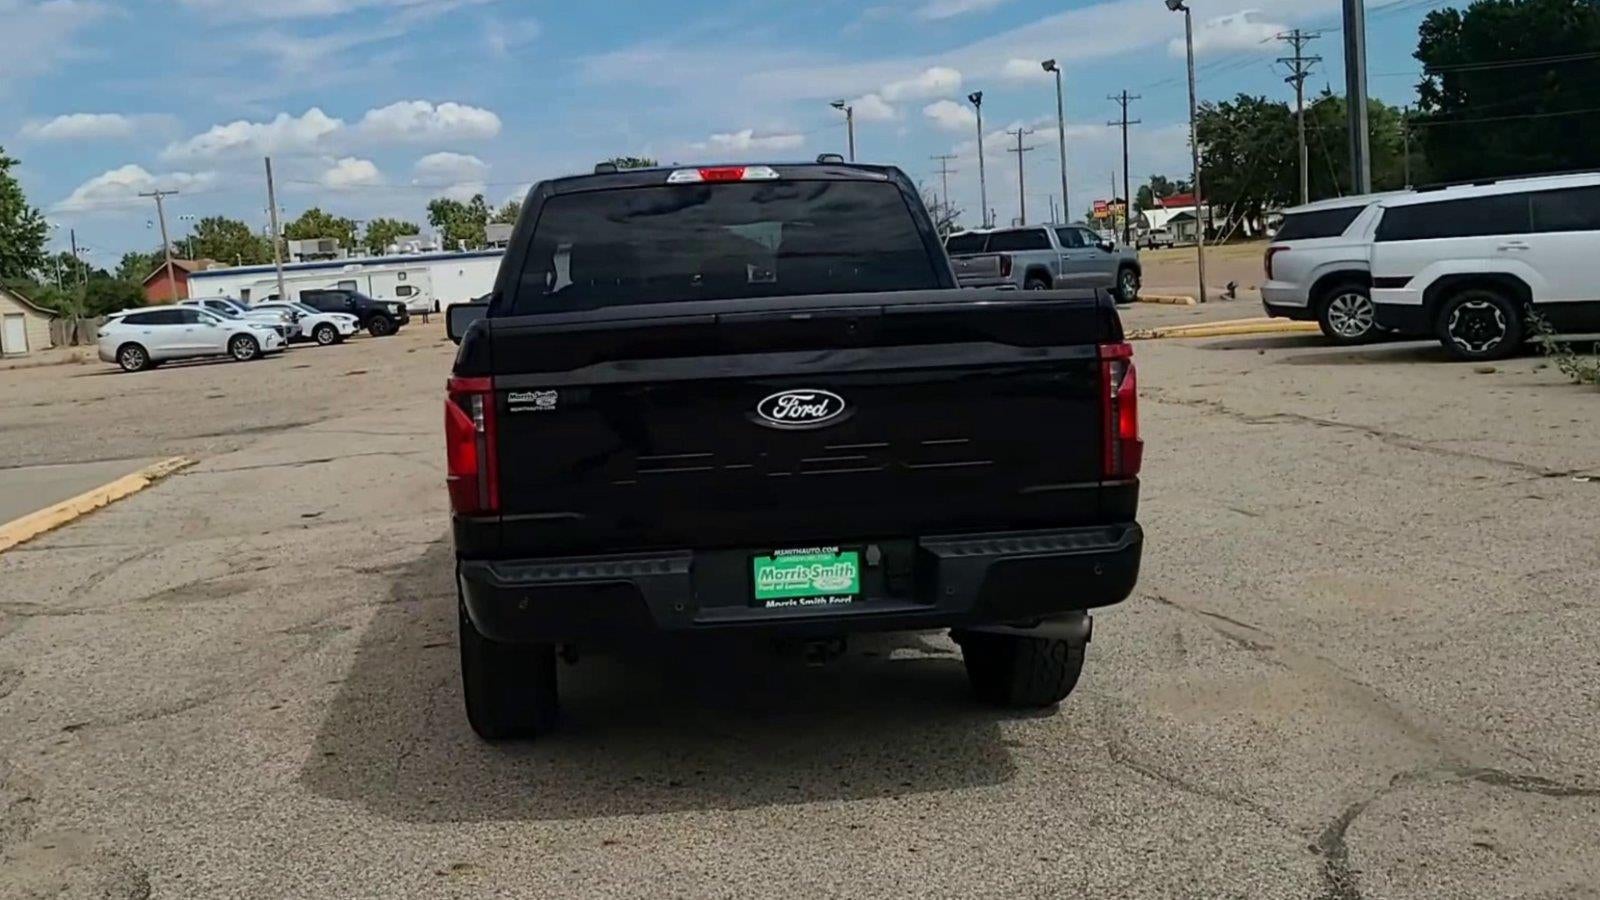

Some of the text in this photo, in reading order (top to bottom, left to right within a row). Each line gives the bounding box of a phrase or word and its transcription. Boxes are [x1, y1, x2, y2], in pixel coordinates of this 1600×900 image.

[772, 394, 829, 419] Ford
[760, 562, 855, 580] Morris Smith
[765, 595, 852, 608] Morris Smith Ford
